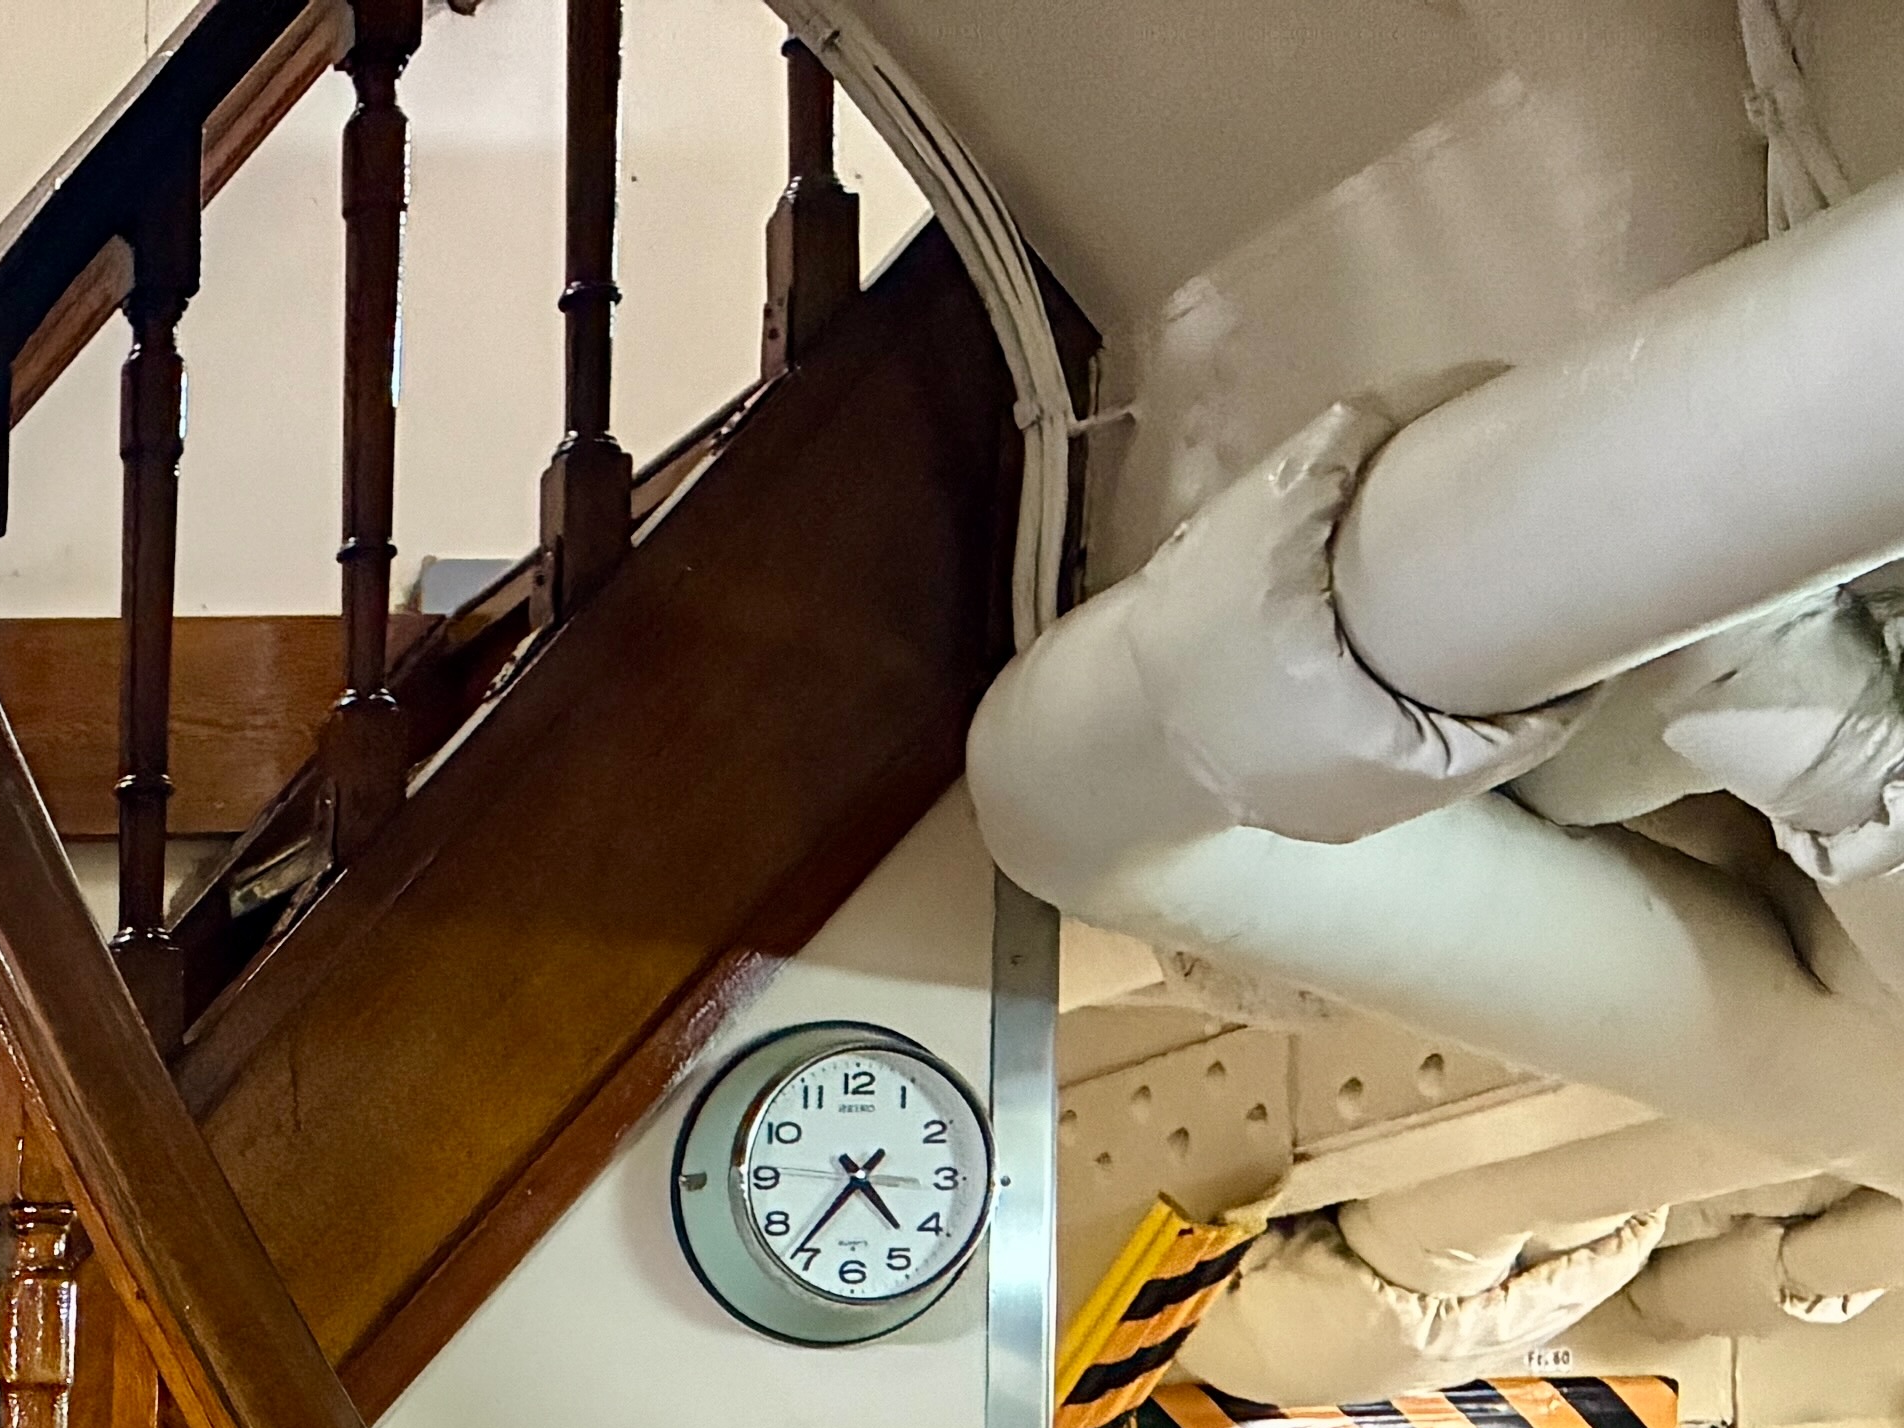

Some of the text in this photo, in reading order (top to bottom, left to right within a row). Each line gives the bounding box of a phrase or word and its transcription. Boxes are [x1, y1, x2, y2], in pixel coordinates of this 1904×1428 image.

[843, 1071, 876, 1095] 12
[802, 1085, 824, 1109] 11
[900, 1085, 907, 1109] 1
[767, 1121, 802, 1144] 10
[922, 1119, 947, 1144] 2
[753, 1165, 781, 1190] 9
[932, 1166, 959, 1191] 3
[764, 1210, 790, 1236] 8
[916, 1211, 943, 1236] 4
[795, 1247, 822, 1272] 7
[886, 1247, 911, 1271] 5
[838, 1260, 867, 1284] 6
